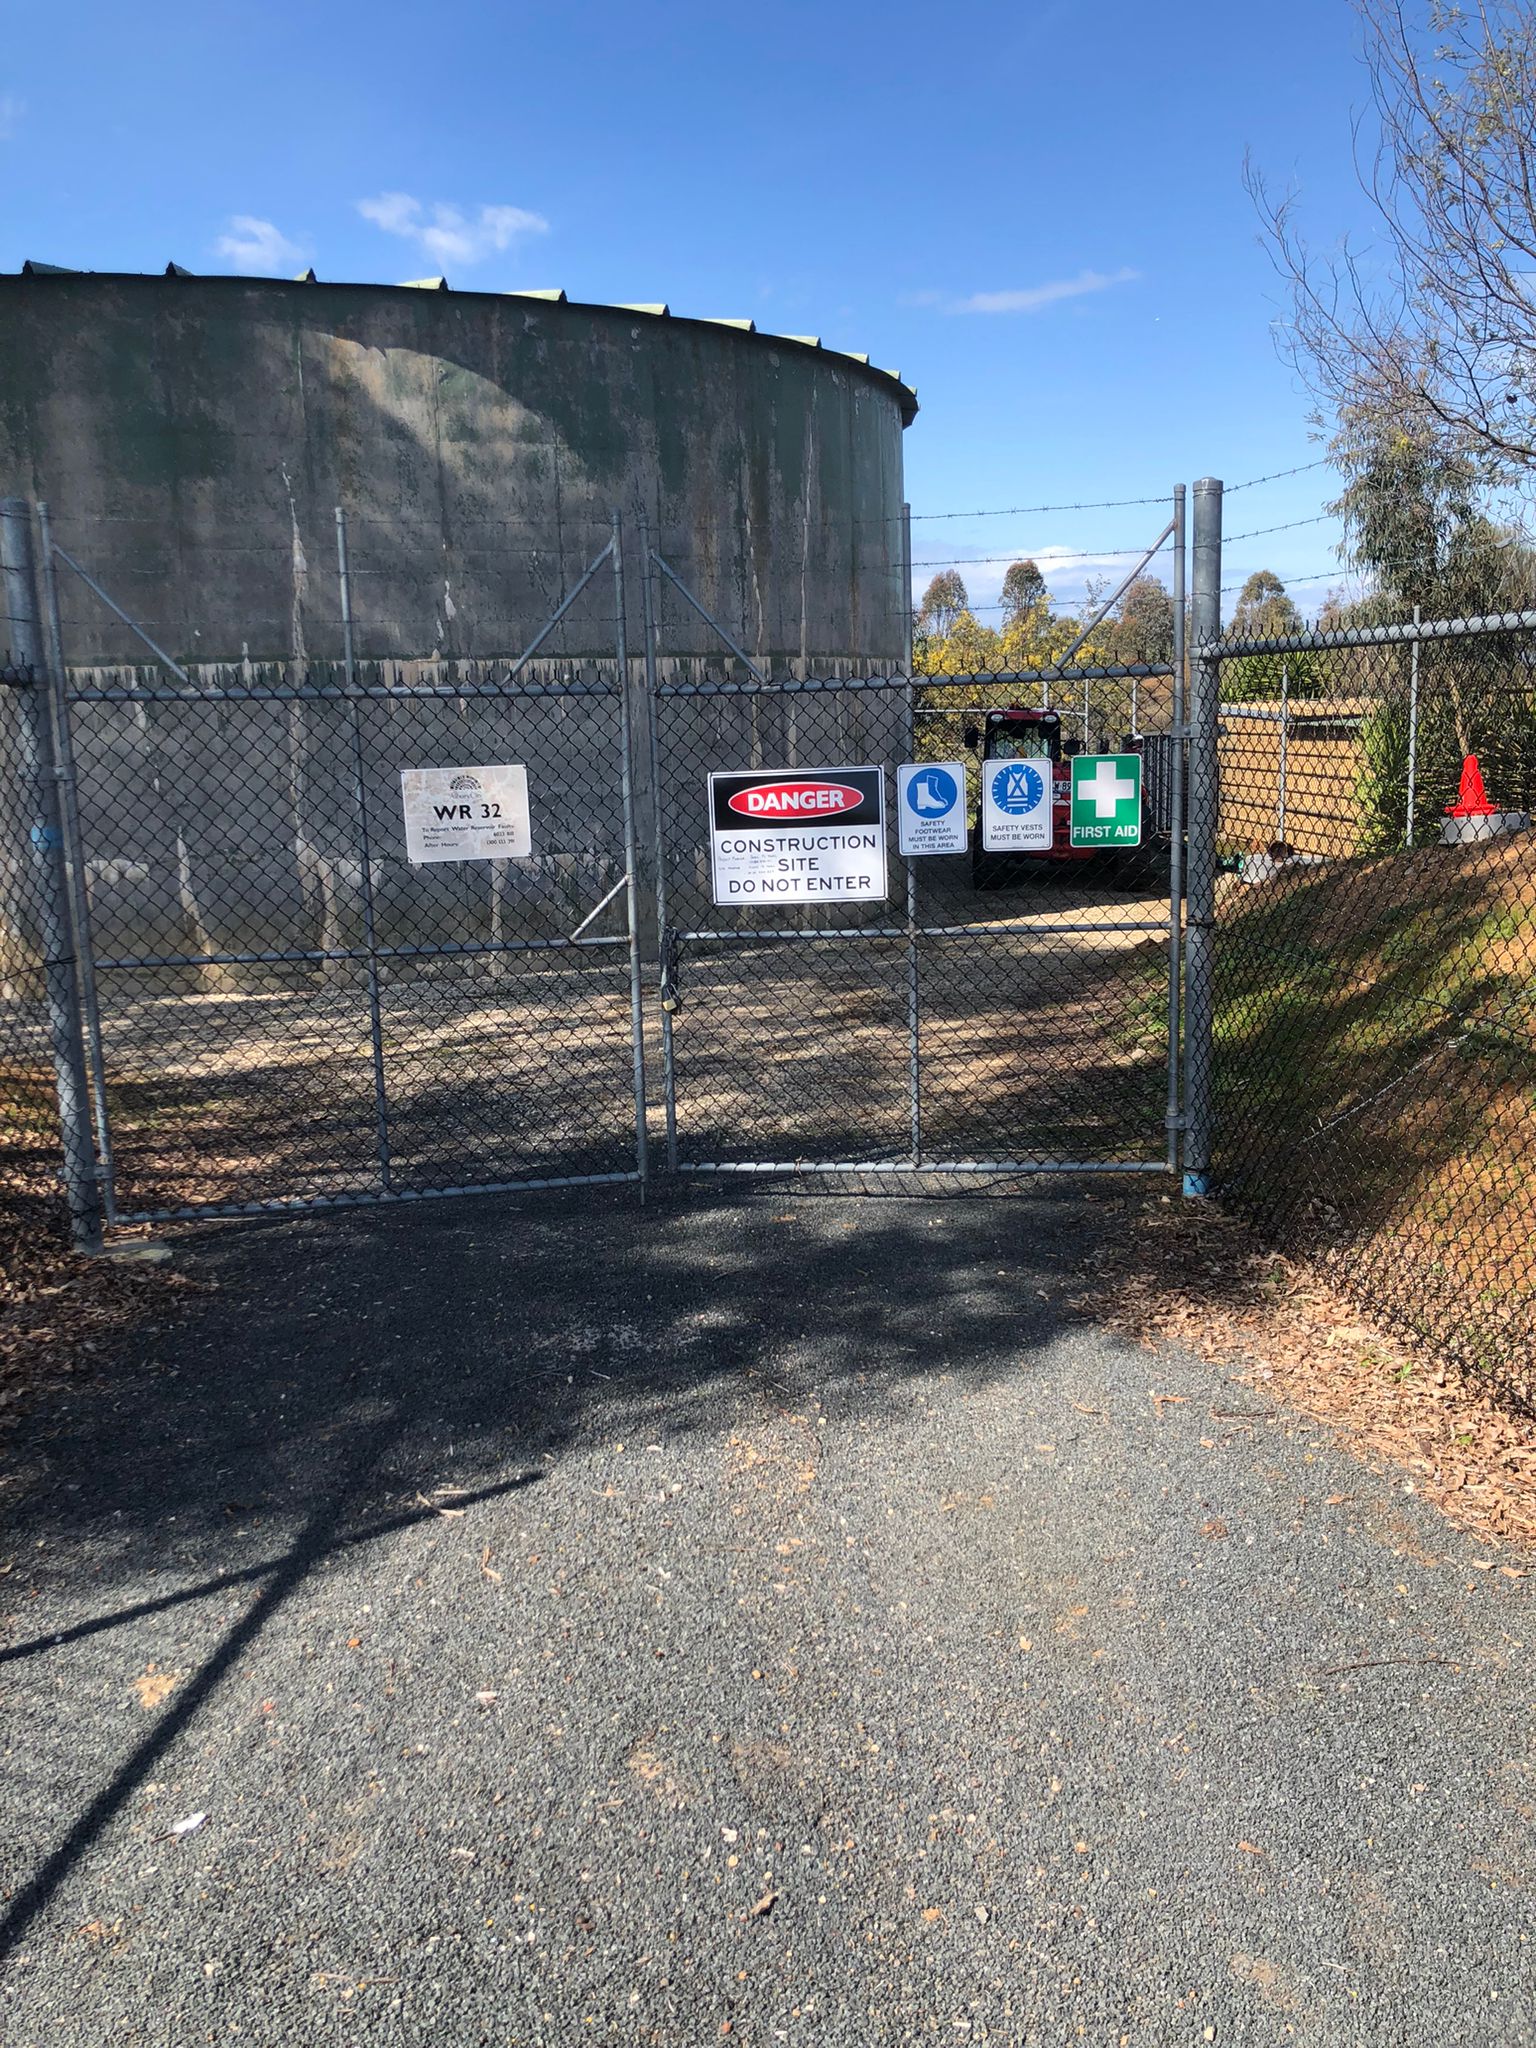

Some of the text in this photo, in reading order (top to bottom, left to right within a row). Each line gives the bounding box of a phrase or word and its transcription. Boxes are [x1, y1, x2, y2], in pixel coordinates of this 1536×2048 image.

[747, 789, 845, 811] DANGER
[433, 803, 502, 820] WR 32
[1073, 825, 1138, 838] FIRST AID
[720, 834, 876, 854] CONSTRUCTION
[778, 857, 819, 872] SITE
[729, 876, 871, 894] DO NOT ENTER
